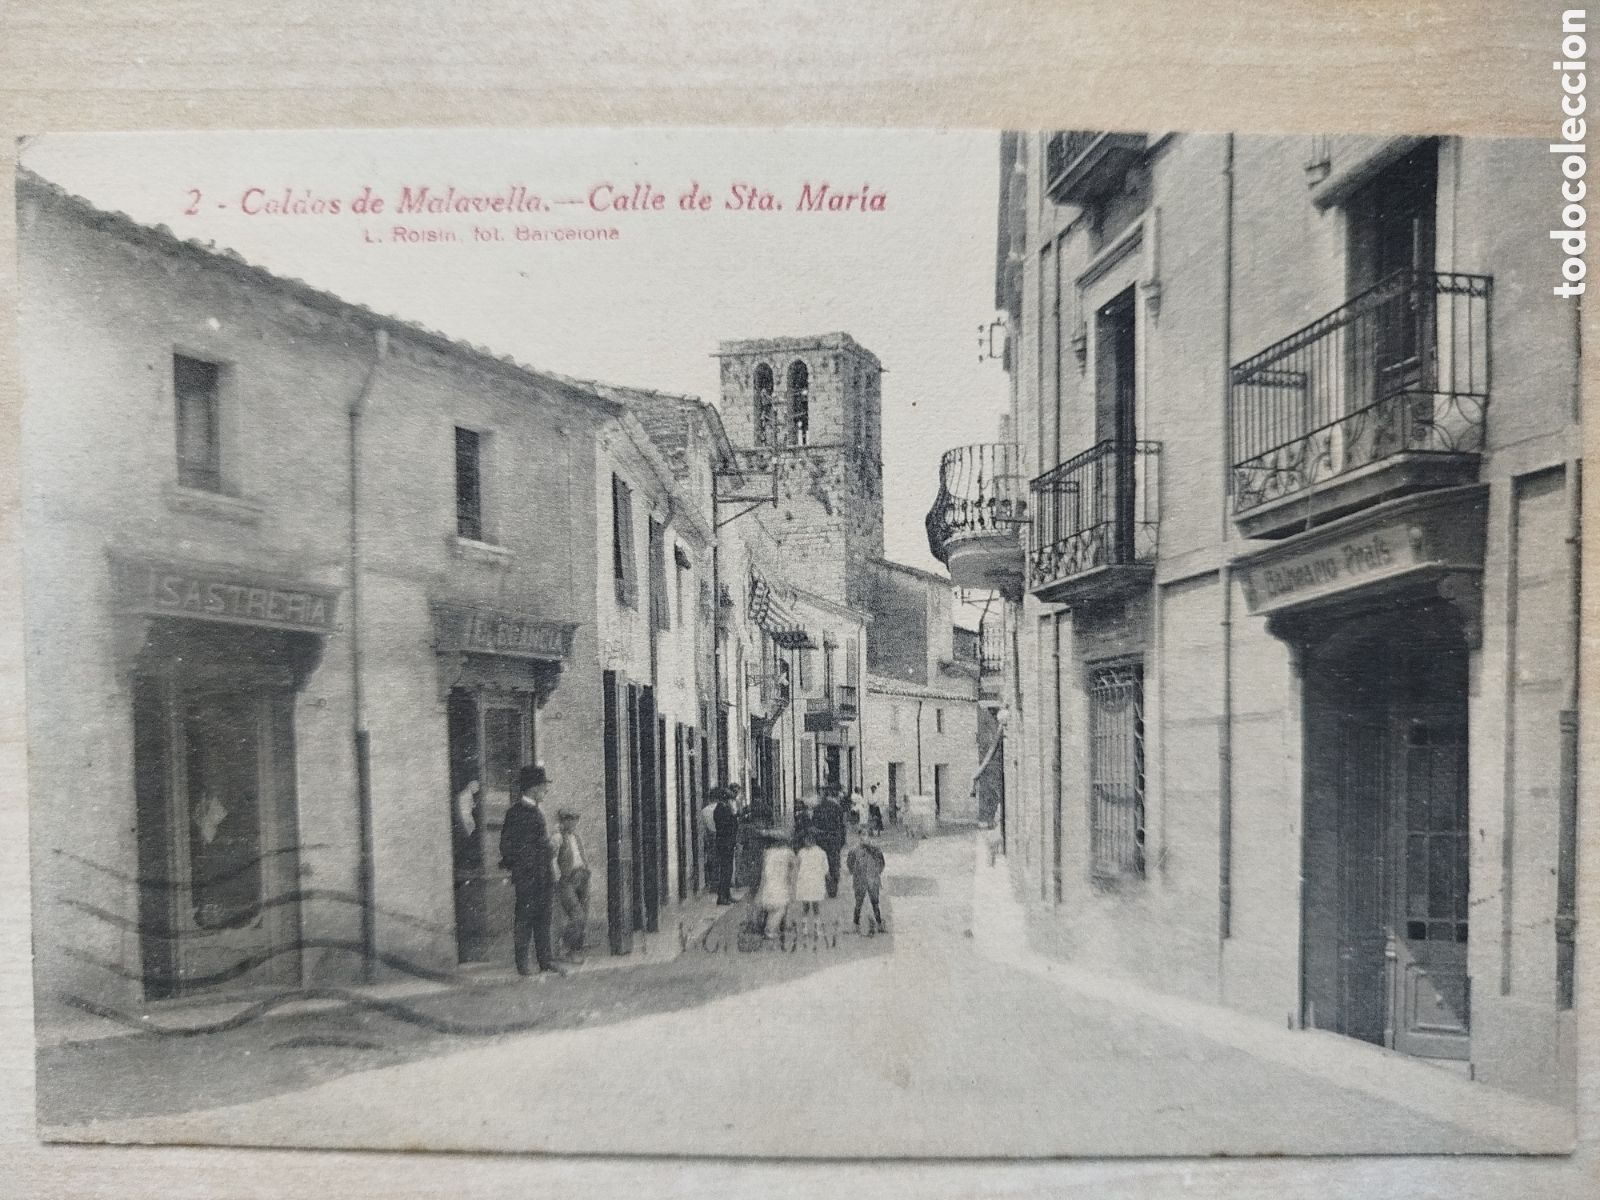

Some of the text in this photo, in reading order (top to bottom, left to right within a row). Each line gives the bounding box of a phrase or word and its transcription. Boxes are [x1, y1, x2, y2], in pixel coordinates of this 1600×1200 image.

[184, 188, 202, 216] 2
[241, 186, 342, 215] Caldas
[351, 186, 385, 215] de
[679, 181, 713, 211] de
[725, 182, 784, 212] Sta.
